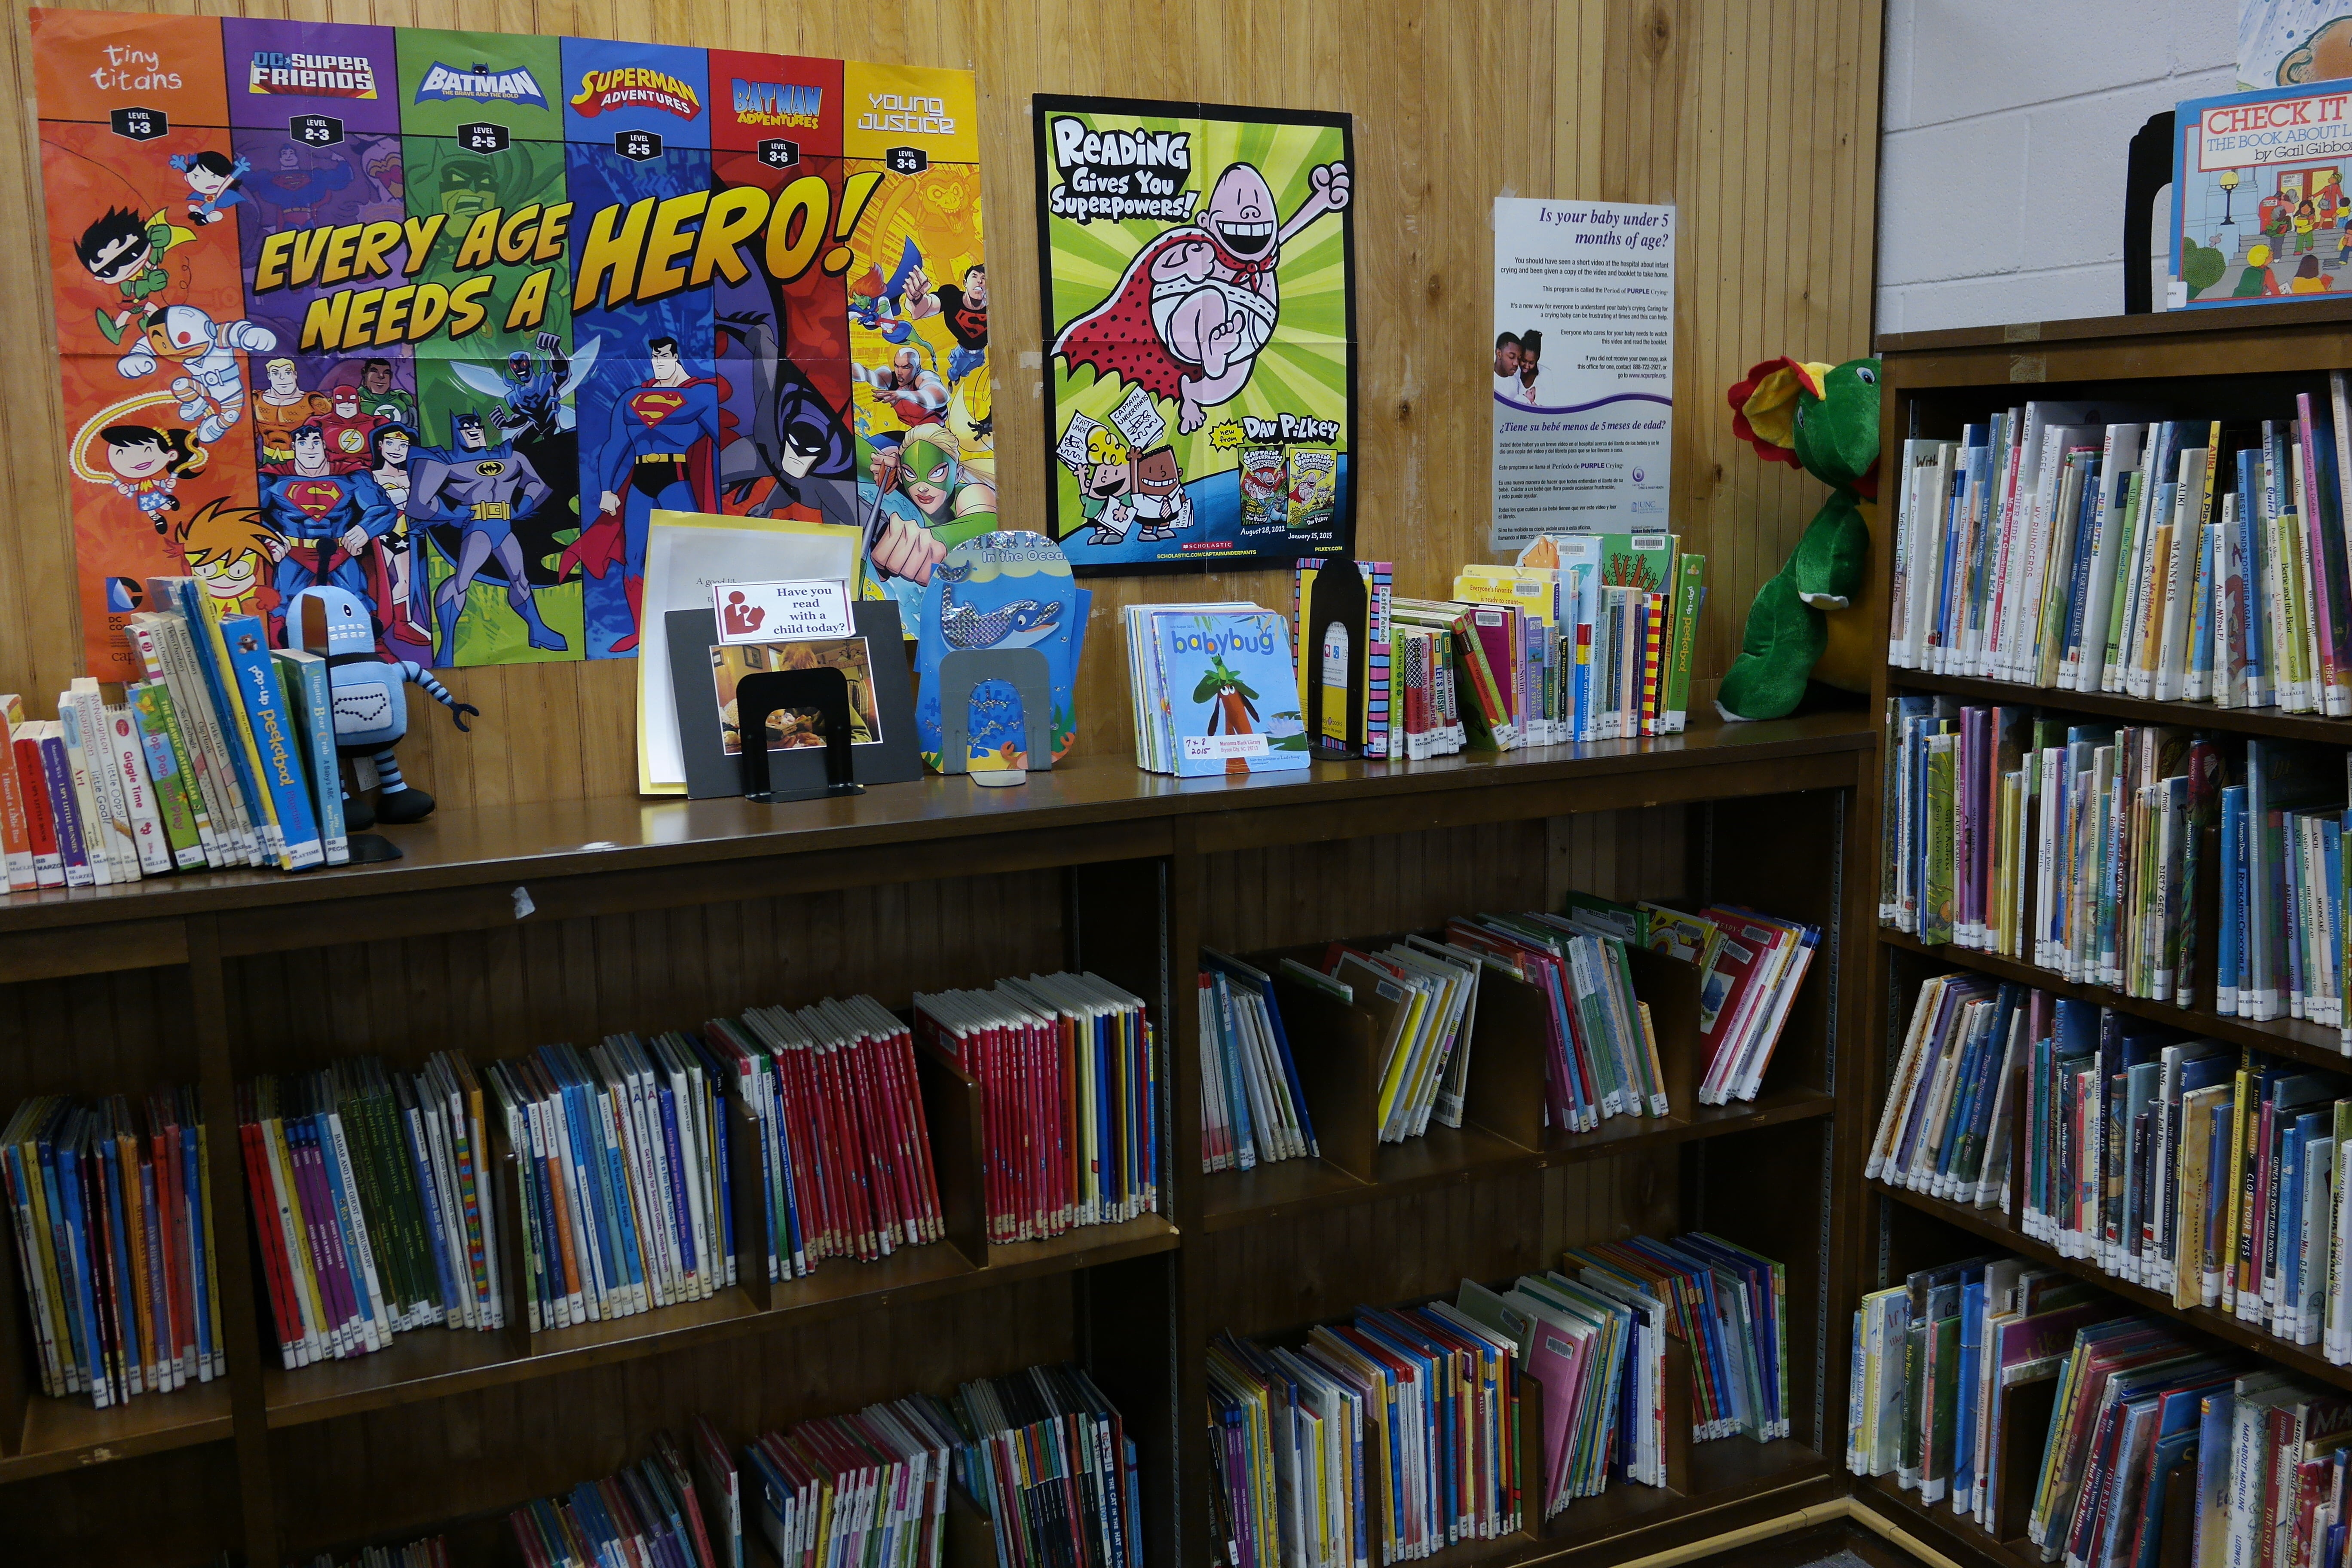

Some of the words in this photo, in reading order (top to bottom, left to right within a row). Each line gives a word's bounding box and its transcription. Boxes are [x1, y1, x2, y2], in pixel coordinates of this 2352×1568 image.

[103, 44, 159, 71] tiny
[254, 52, 284, 66] DC
[291, 53, 369, 71] SUPER
[90, 67, 182, 90] titans
[253, 68, 373, 90] FRIENDS
[422, 67, 542, 95] BATMAN
[570, 67, 700, 107] SUPERMAN
[600, 90, 690, 115] ADVENTURES
[731, 78, 822, 116] BATMAN
[737, 112, 819, 129] ADVENTURES
[2208, 101, 2311, 135] CHECK
[2318, 97, 2347, 122] IT
[129, 121, 151, 134] 1-3
[305, 129, 330, 141] 2-3
[2207, 137, 2235, 151] THE
[2239, 130, 2282, 147] BOOK
[2286, 125, 2340, 143] ABOUT
[472, 136, 496, 148] 2-5
[628, 143, 650, 155] 2-5
[2255, 150, 2272, 162] by
[2275, 144, 2303, 158] Gail
[769, 151, 788, 162] 3-6
[897, 158, 916, 169] 3-6
[1072, 167, 1129, 194] Gives
[1135, 171, 1173, 196] You
[1539, 207, 1552, 222] Is
[1556, 210, 1586, 225] your
[1590, 209, 1620, 227] baby
[1623, 211, 1659, 226] under
[1661, 213, 1669, 227] 5
[255, 213, 445, 292] EVERY
[456, 201, 573, 271] AGE
[1575, 231, 1621, 245] months
[1626, 232, 1639, 249] of
[1641, 233, 1669, 250] age?
[301, 276, 496, 351] NEEDS
[504, 267, 552, 331] A
[572, 171, 885, 312] HERO!
[1114, 393, 1139, 419] CAPTAIN
[1118, 395, 1148, 425] UNDERPANTS
[1243, 418, 1277, 439] DAV
[1500, 422, 1527, 433] ¿Tiene
[1542, 421, 1561, 431] bebé
[1563, 423, 1587, 431] menos
[1590, 422, 1599, 430] de
[1602, 422, 1606, 430] 5
[1632, 420, 1642, 429] de
[1644, 420, 1666, 429] edad?
[1242, 456, 1283, 465] UNDERPANTS
[1294, 458, 1334, 467] UNDERPANTS
[2178, 482, 2186, 505] ALIKI
[1240, 527, 1262, 536] August
[1288, 533, 1310, 541] January
[982, 551, 995, 563] In
[1000, 550, 1023, 562] the
[1157, 550, 1256, 559] SCHOLASTIC.COM/CAPTAINUNDERPANTS
[2166, 540, 2180, 601] MANNERS
[777, 588, 808, 597] Have
[811, 588, 832, 597] you
[1470, 585, 1494, 594] Everyone's
[1485, 596, 1498, 604] ready
[793, 599, 820, 608] read
[789, 612, 817, 621] with
[774, 625, 803, 634] child
[807, 623, 845, 634] today?
[1380, 616, 1388, 643] Parade
[1171, 628, 1274, 655] babybug
[248, 665, 269, 705] pop-up
[258, 709, 295, 787] peekaboo!
[124, 751, 137, 783] Giggle
[132, 786, 142, 808] Time
[2244, 1206, 2252, 1229] YOUR
[2242, 1233, 2251, 1256] EYES
[2335, 1238, 2343, 1265] EXTRA
[2334, 1271, 2342, 1296] YARN
[2239, 1470, 2247, 1512] MADELINE
